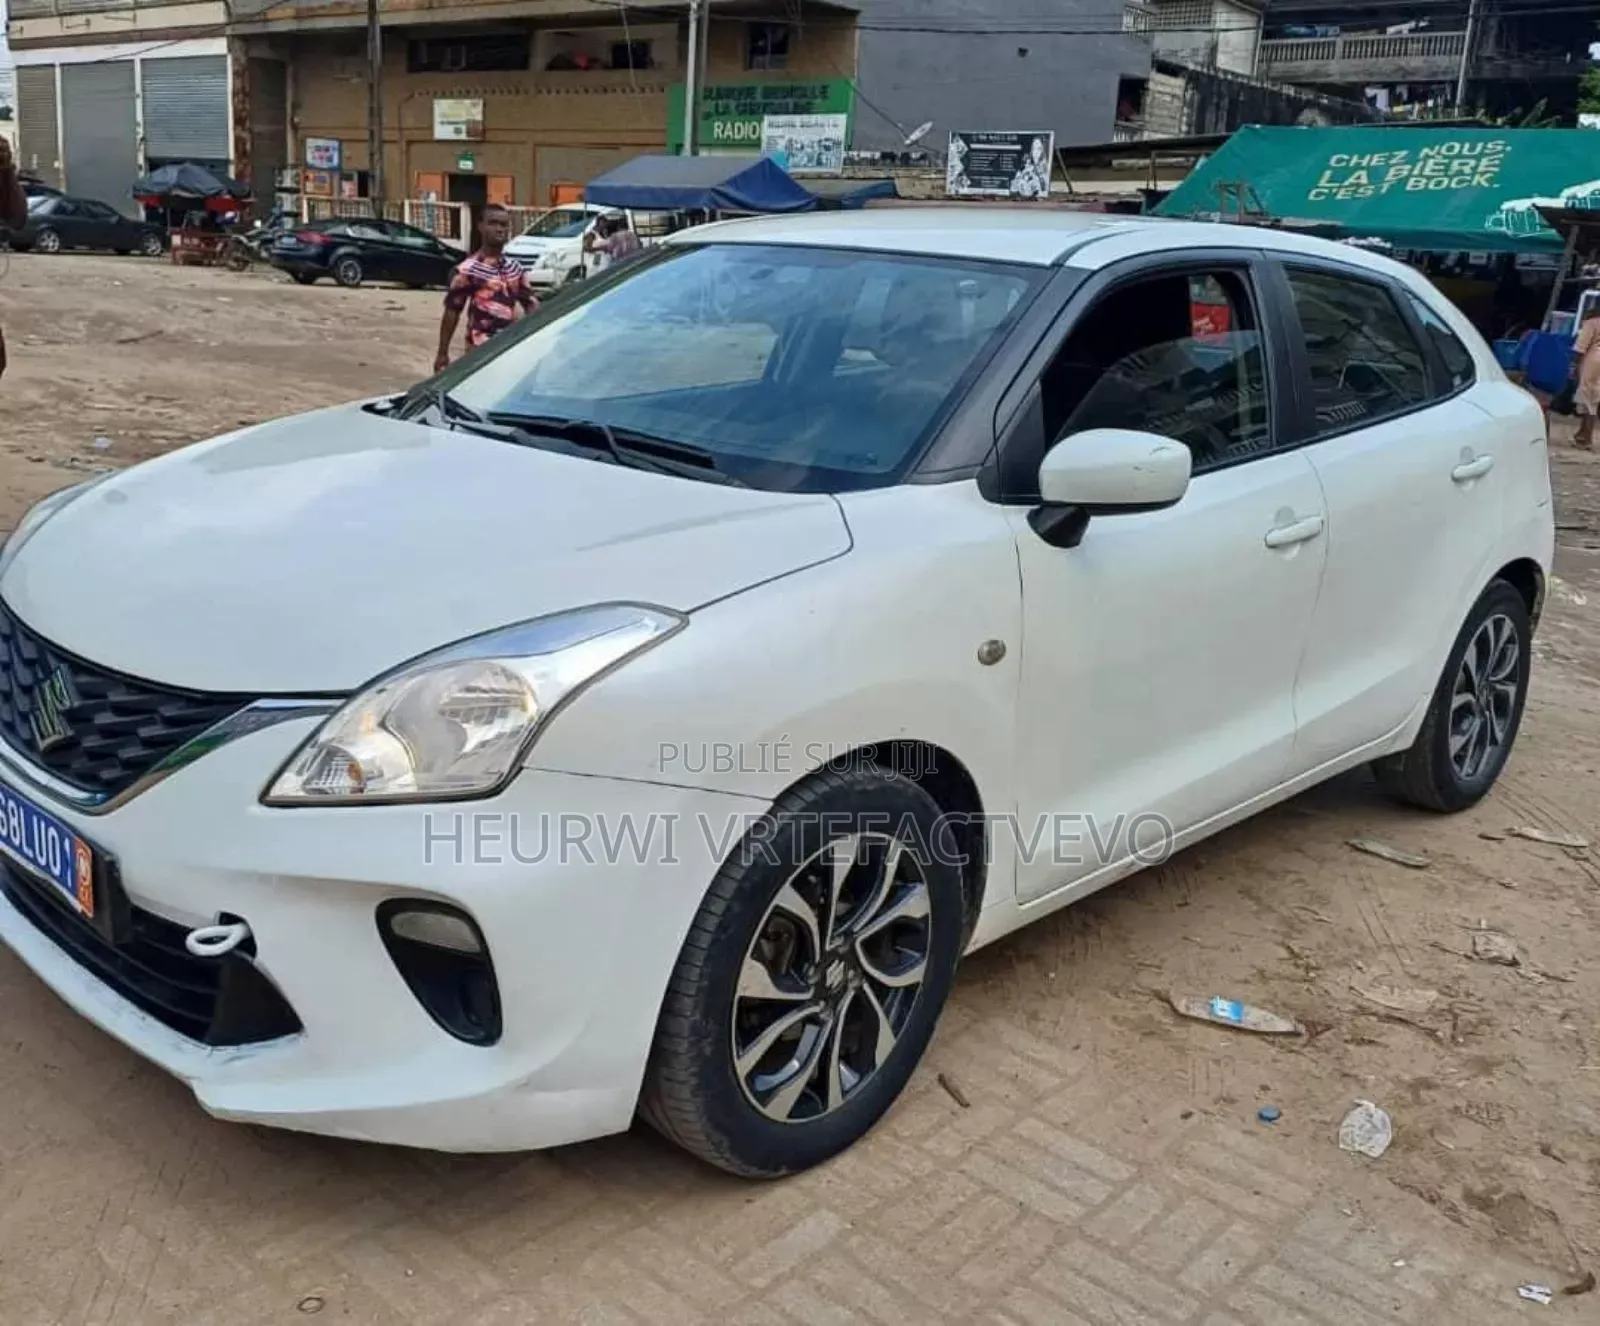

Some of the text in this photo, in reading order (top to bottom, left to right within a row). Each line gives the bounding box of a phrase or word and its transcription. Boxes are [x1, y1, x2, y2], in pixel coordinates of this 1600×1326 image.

[713, 121, 764, 140] RADIO
[1329, 150, 1409, 167] CHEZ
[1317, 154, 1504, 187] LA BIÈRE
[1308, 173, 1501, 201] C'EST BOCK.
